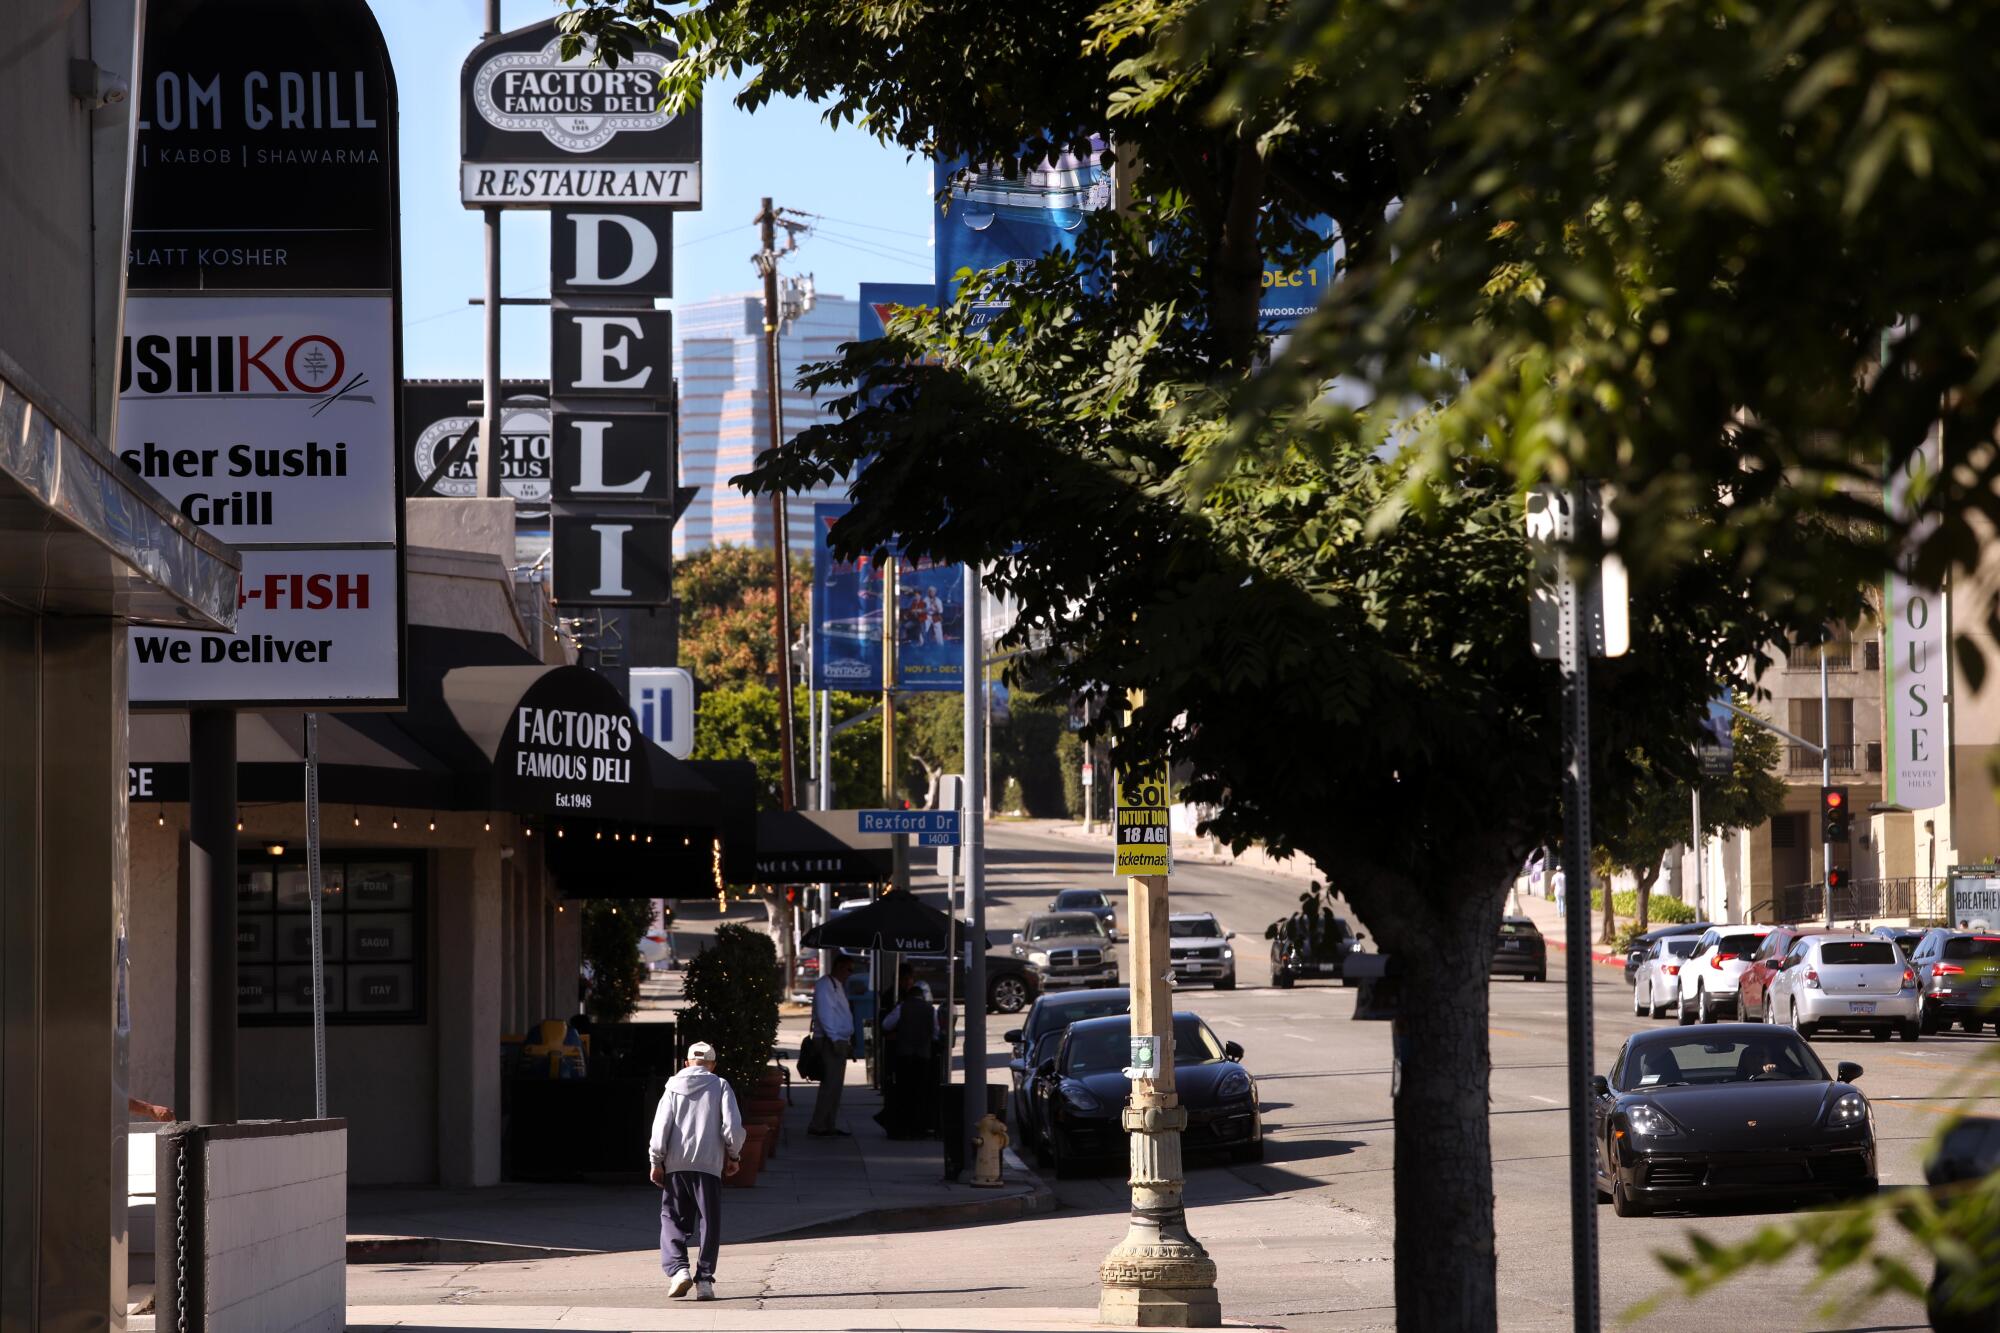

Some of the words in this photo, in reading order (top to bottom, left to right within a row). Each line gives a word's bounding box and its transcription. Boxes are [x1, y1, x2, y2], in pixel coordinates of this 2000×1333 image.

[505, 71, 653, 95] FACTOR'S
[244, 71, 377, 130] GRILL
[505, 97, 593, 112] FAMOUS
[604, 97, 655, 112] DELI
[160, 149, 231, 163] KABOB
[257, 149, 379, 163] SHAWARMA
[475, 169, 688, 196] RESTAURANT
[200, 248, 288, 266] KOSHER
[229, 443, 347, 478] Sushi
[181, 491, 272, 526] Grill
[135, 637, 191, 663] We
[201, 634, 333, 663] Deliver
[518, 707, 632, 752] FACTOR'S
[517, 751, 587, 781] FAMOUS
[592, 757, 630, 783] DELI
[865, 814, 926, 829] Rexford
[936, 815, 953, 829] Dr
[1119, 810, 1150, 825] INTUIT
[928, 834, 949, 844] 1400
[1124, 827, 1141, 843] 18
[895, 938, 931, 949] Valet
